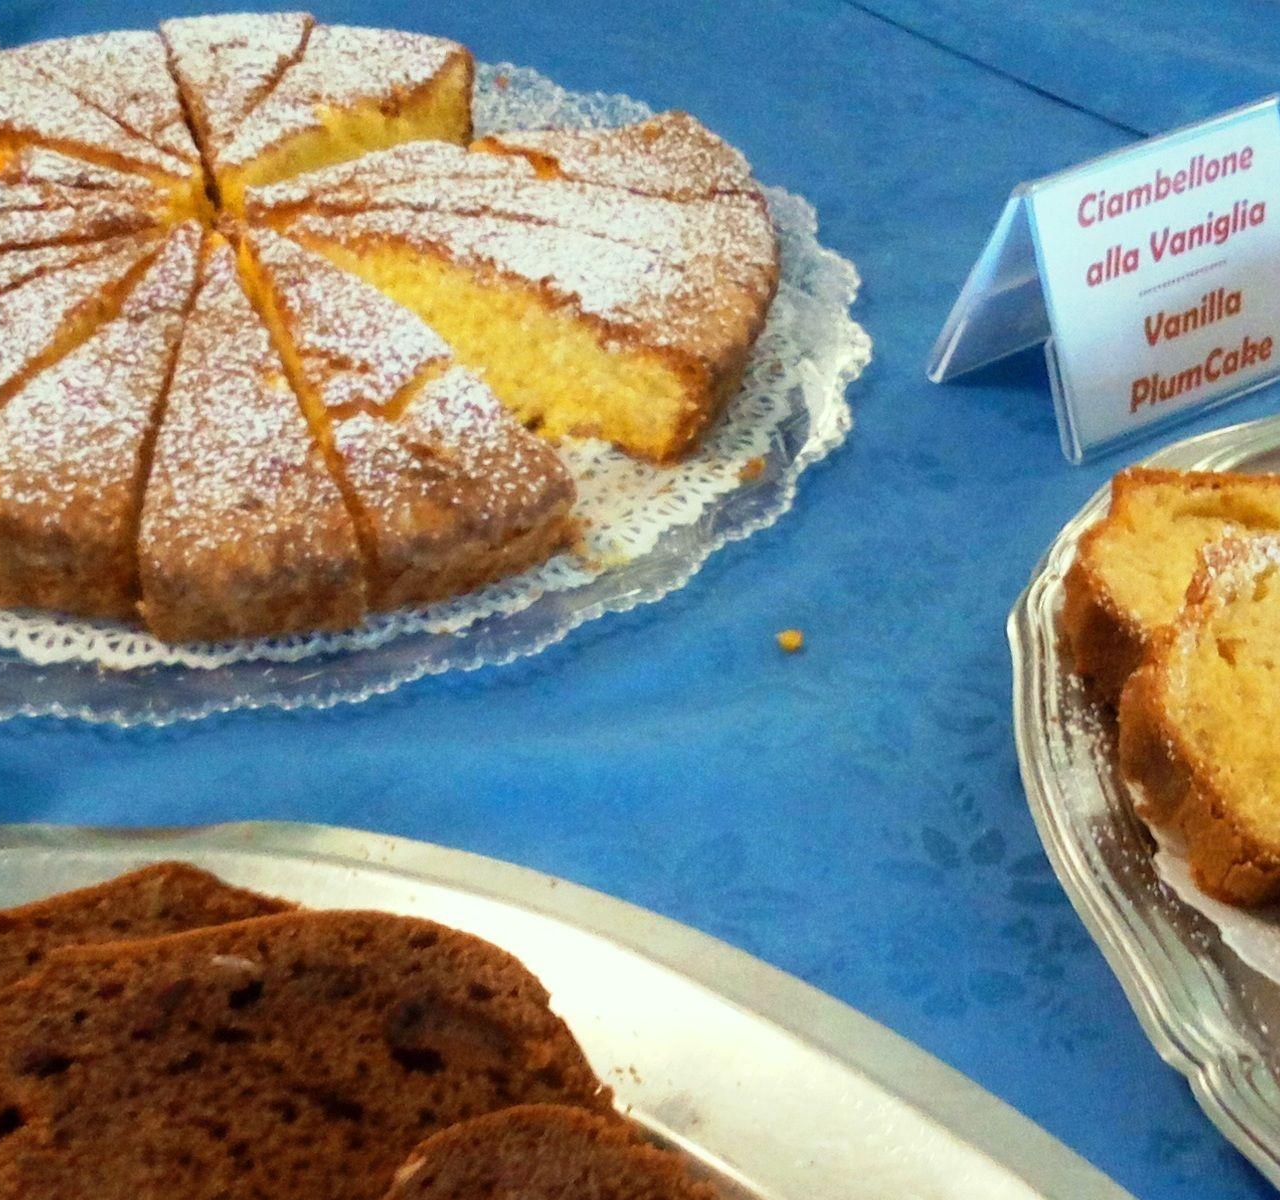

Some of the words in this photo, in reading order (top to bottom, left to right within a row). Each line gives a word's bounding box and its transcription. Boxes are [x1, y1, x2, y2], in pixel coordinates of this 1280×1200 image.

[1077, 145, 1254, 228] Ciambellone
[1086, 244, 1140, 288] alla
[1149, 199, 1266, 263] Vaniglia
[1143, 287, 1243, 347] Vanilla
[1129, 334, 1273, 414] PlumCake
